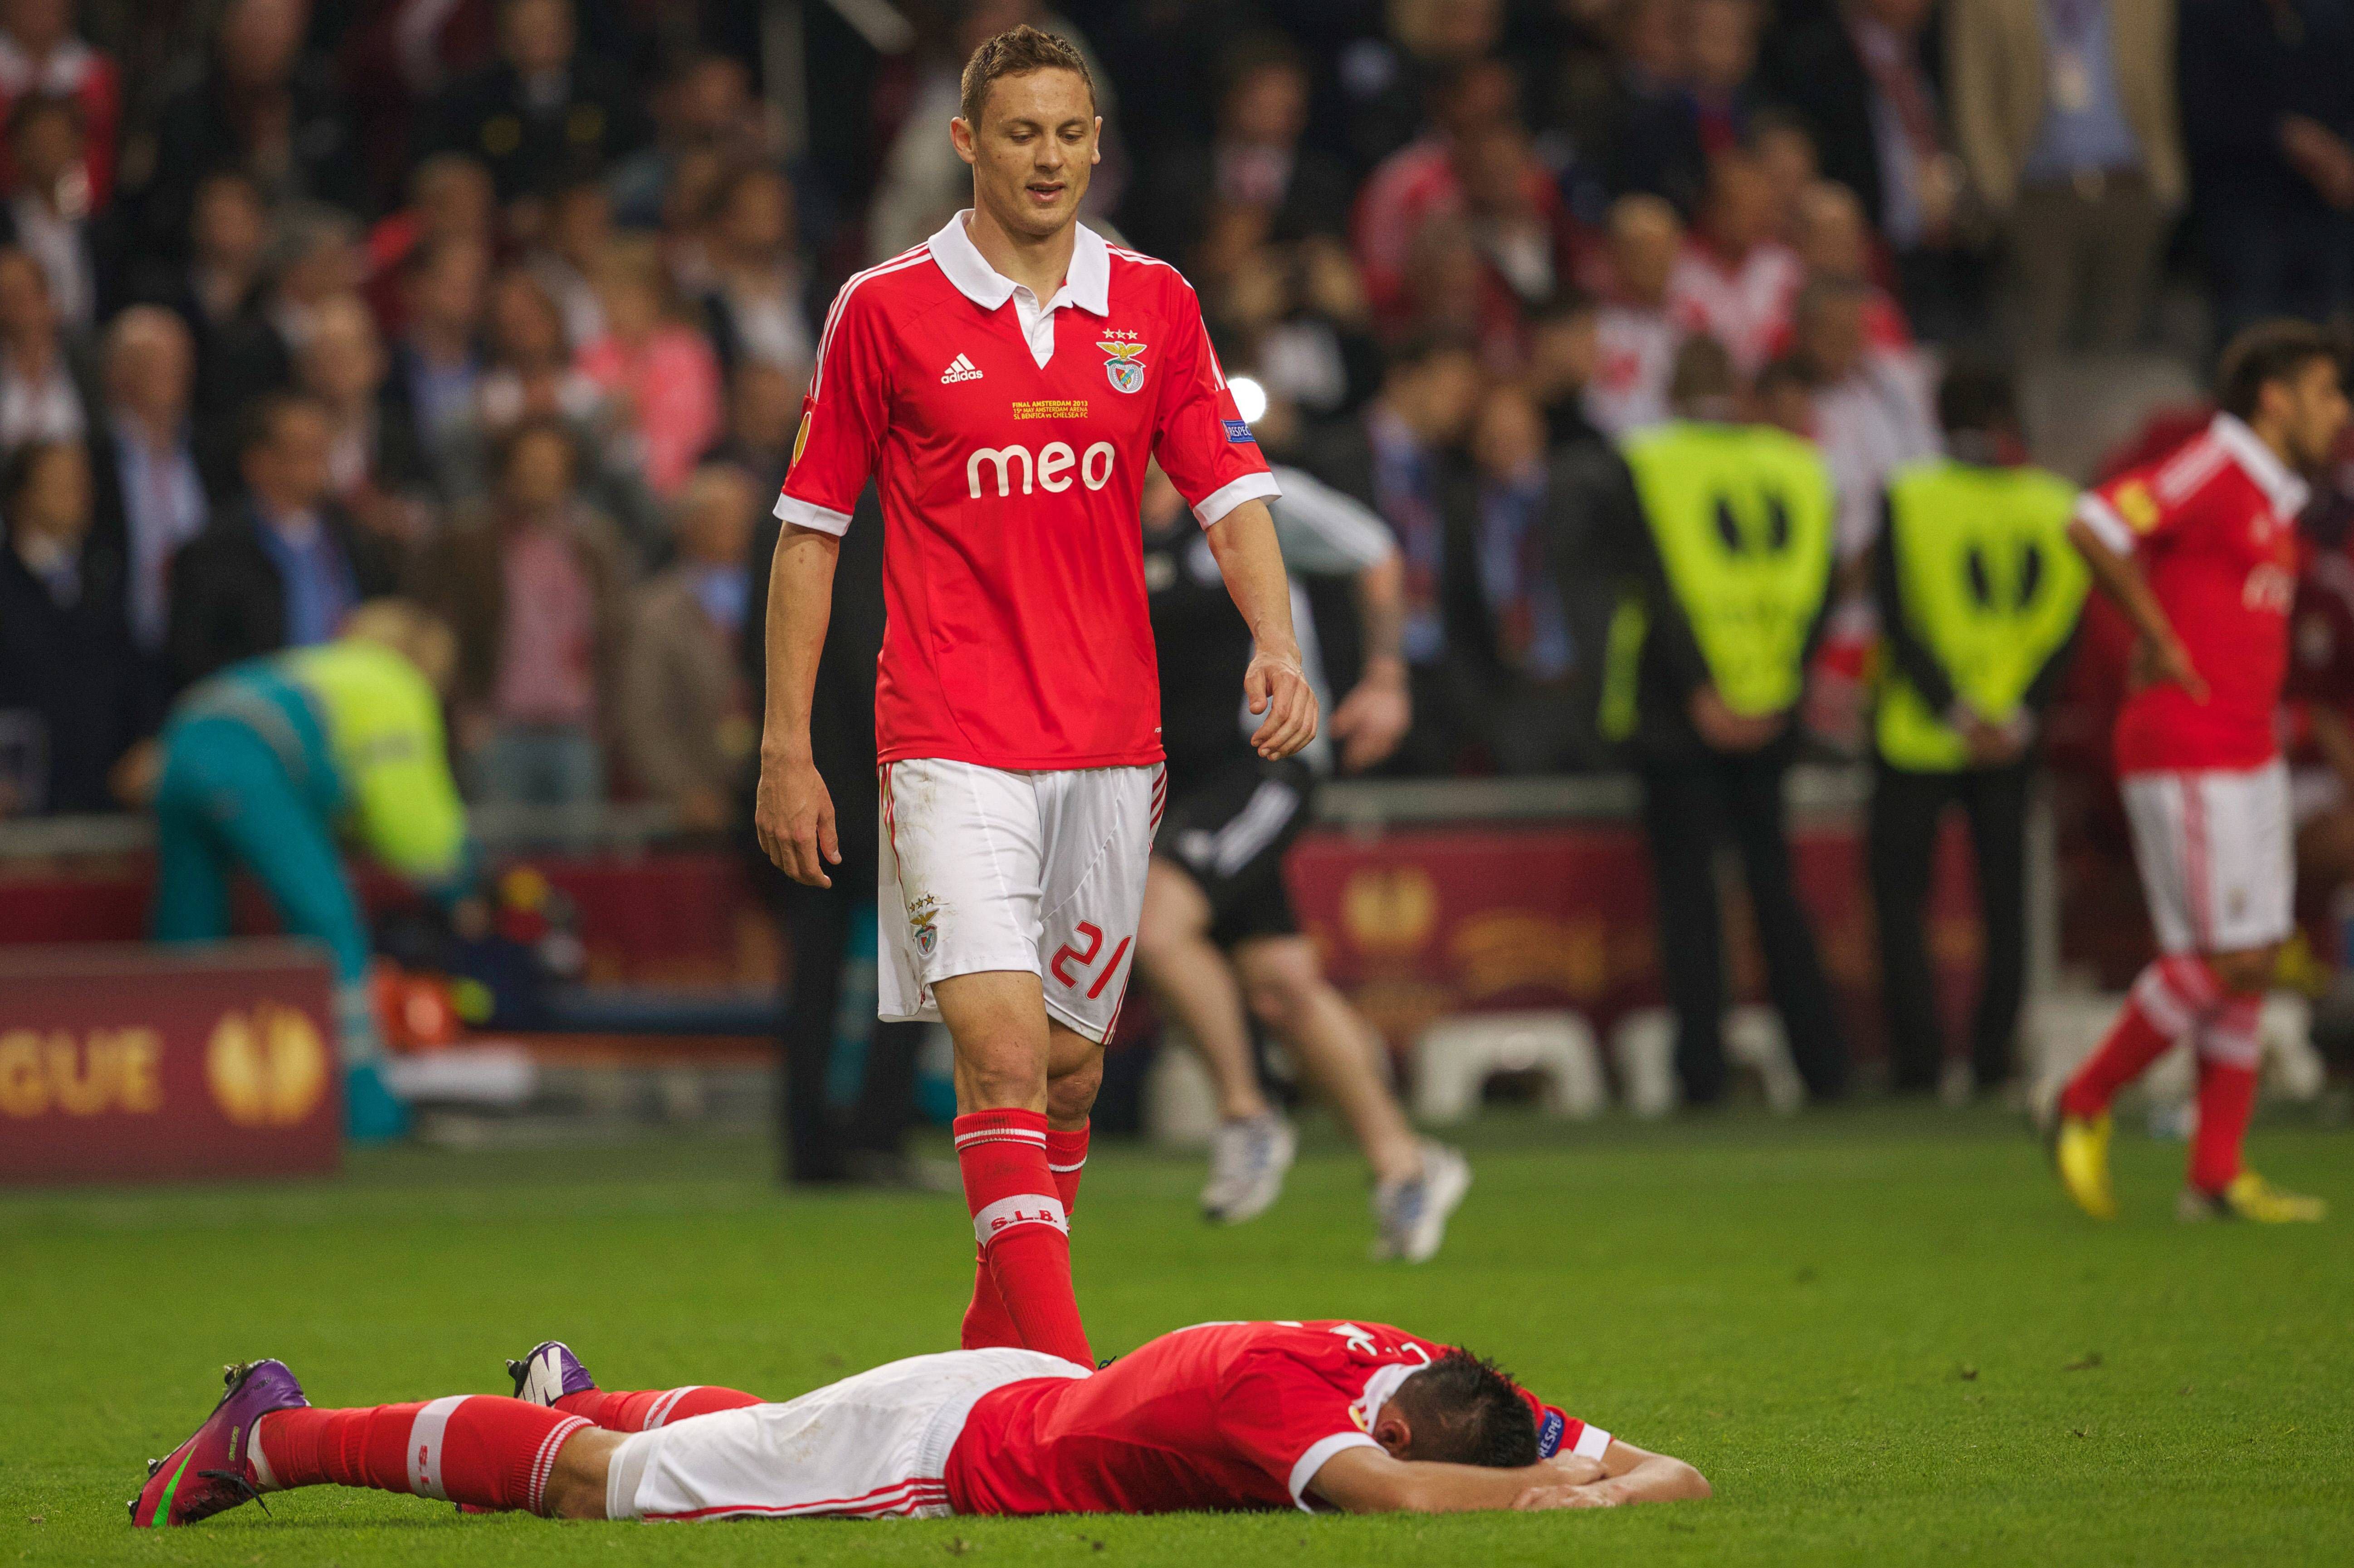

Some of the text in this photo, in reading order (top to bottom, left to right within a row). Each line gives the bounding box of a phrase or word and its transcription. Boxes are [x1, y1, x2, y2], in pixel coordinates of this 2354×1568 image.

[941, 370, 983, 384] adidas
[967, 441, 1115, 499] meo
[1050, 920, 1133, 1001] 21
